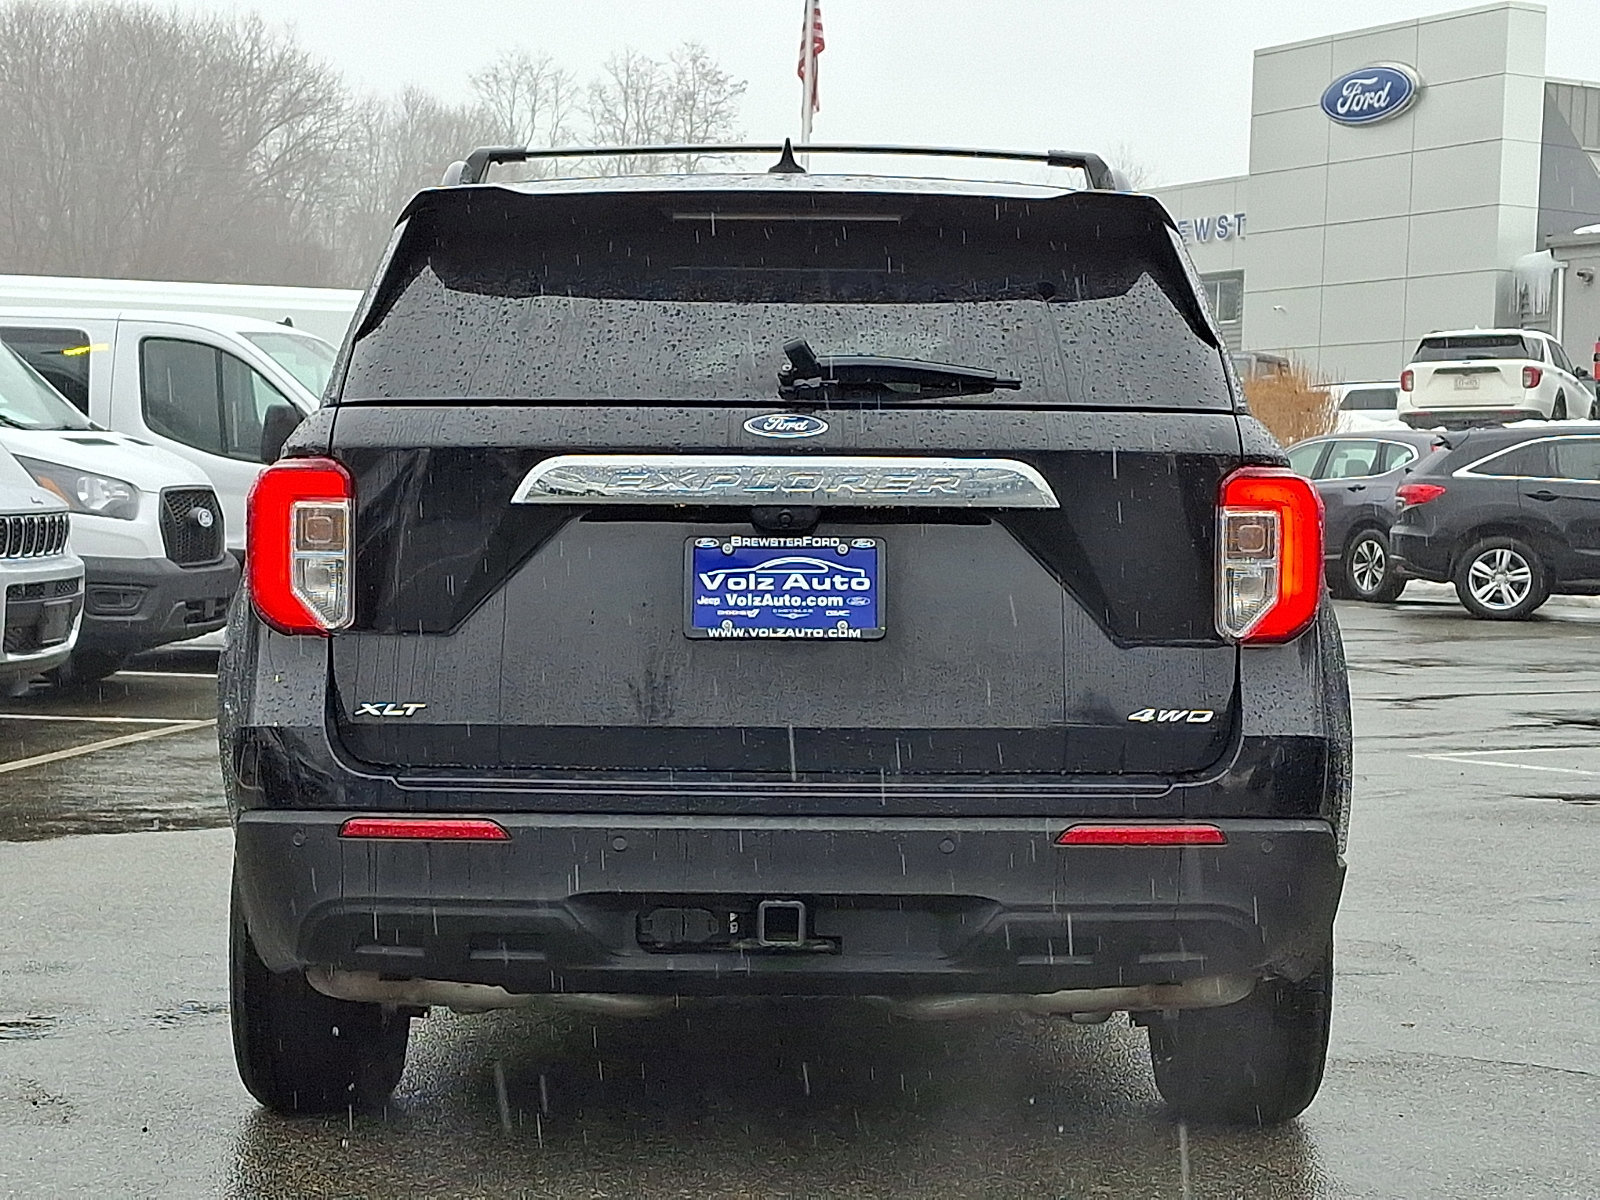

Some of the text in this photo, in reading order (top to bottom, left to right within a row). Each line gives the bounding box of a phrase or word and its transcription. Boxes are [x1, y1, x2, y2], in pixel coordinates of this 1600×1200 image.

[1336, 76, 1389, 114] Ford
[763, 416, 809, 431] Ford
[604, 472, 960, 493] EXPLORER
[699, 573, 871, 590] Volz Auto
[697, 595, 720, 606] Jeep
[725, 594, 843, 607] VolzAuto.com
[708, 627, 862, 638] WWW.VOLZAUTO.COM
[354, 703, 427, 716] XLT
[1128, 708, 1214, 723] 4WD
